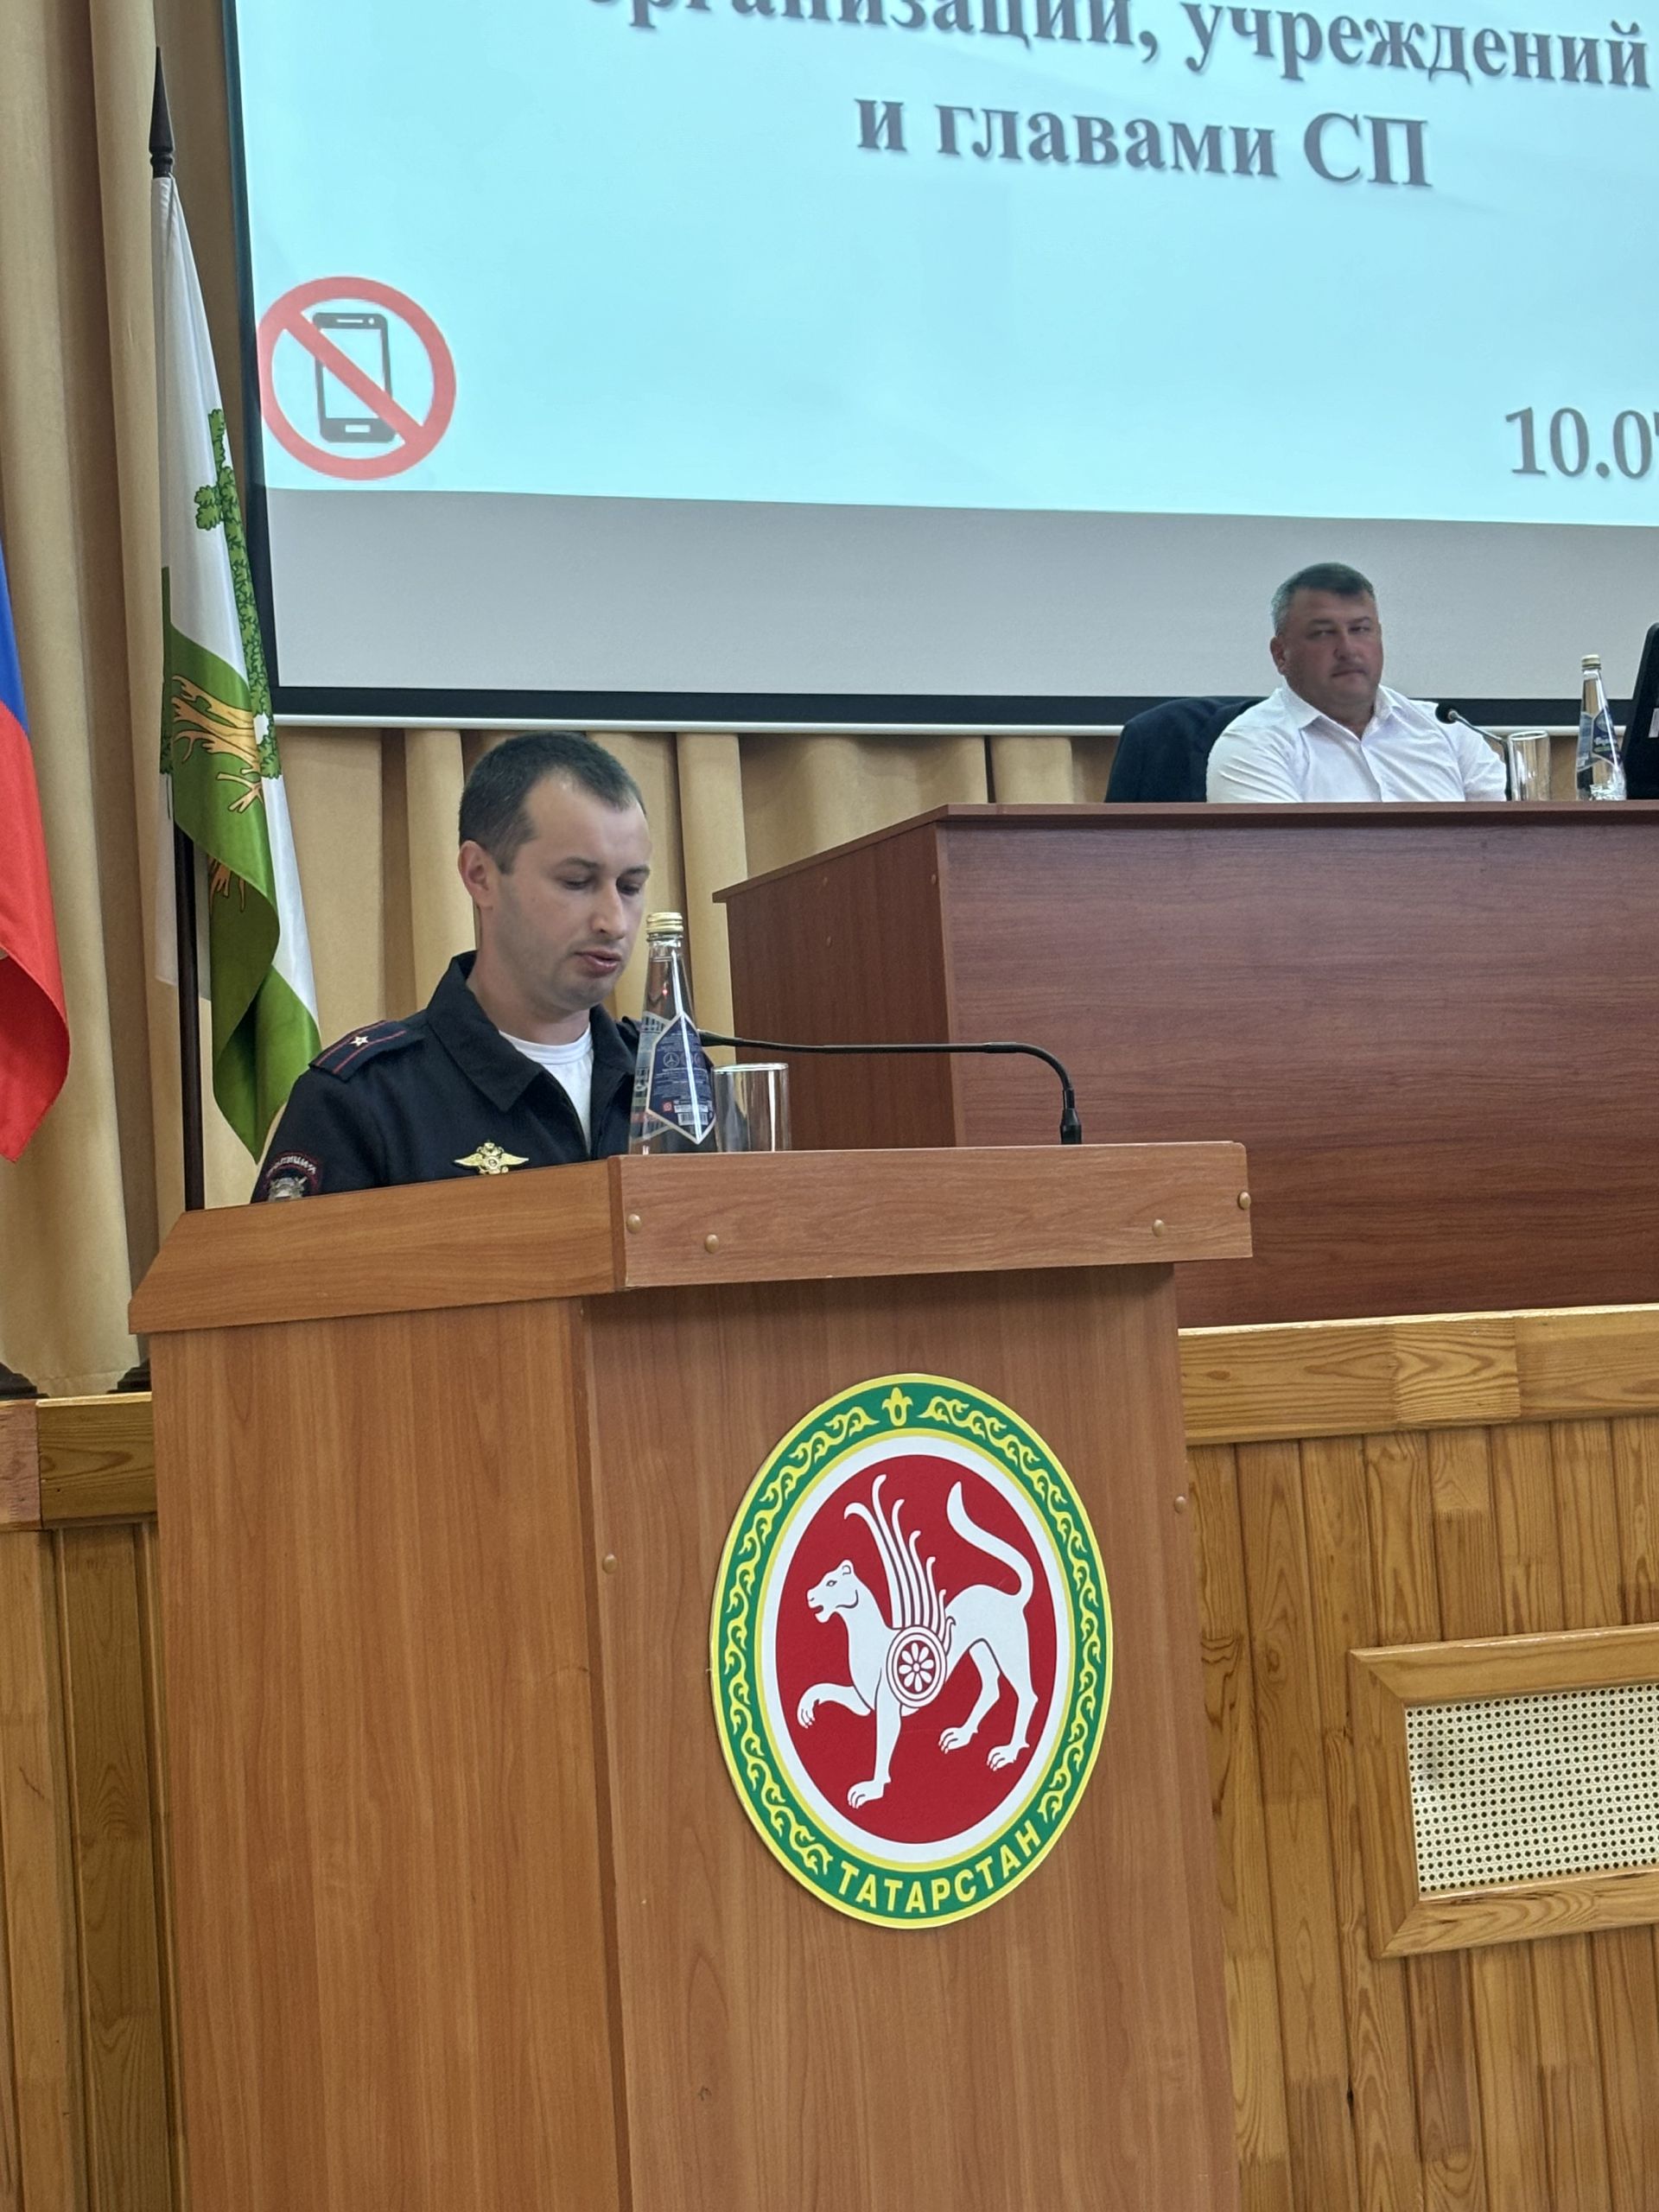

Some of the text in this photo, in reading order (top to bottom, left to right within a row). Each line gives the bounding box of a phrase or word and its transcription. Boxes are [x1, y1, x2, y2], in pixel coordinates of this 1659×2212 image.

[1179, 2, 1649, 87] учреждений
[854, 99, 1432, 188] и главами СП
[1505, 406, 1659, 480] 10.0
[838, 1819, 1041, 1913] ТАТАРСТАН
